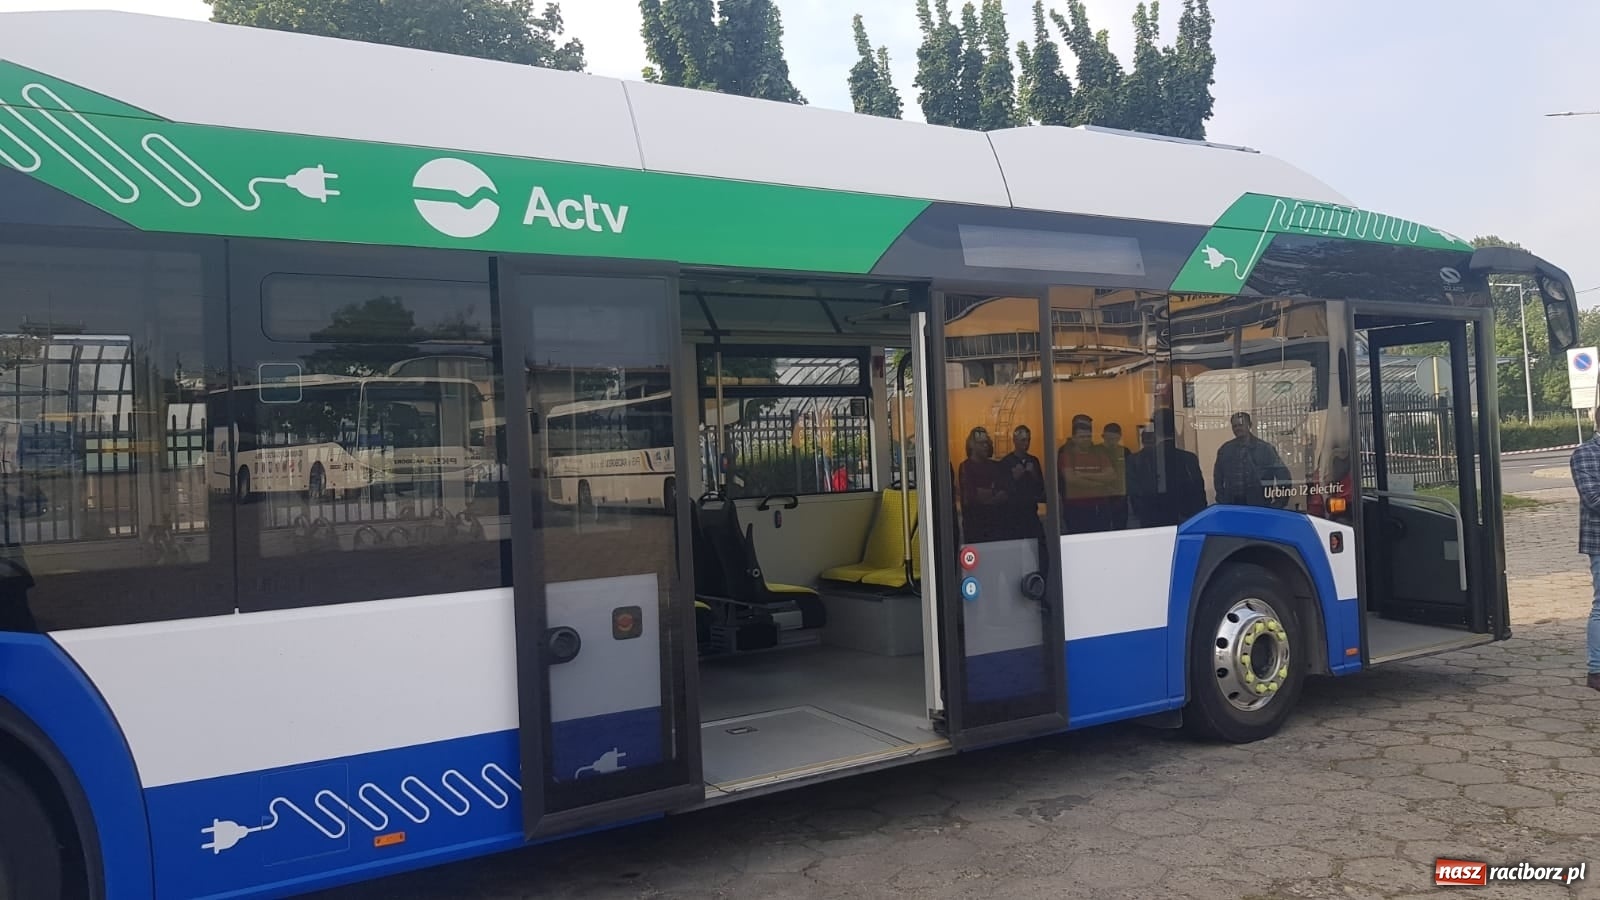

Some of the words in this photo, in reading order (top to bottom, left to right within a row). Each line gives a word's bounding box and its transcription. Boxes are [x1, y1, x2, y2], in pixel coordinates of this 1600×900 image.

[523, 186, 629, 233] Actv
[1264, 485, 1297, 498] Urbino
[1299, 484, 1309, 496] 12
[1309, 482, 1345, 495] electric
